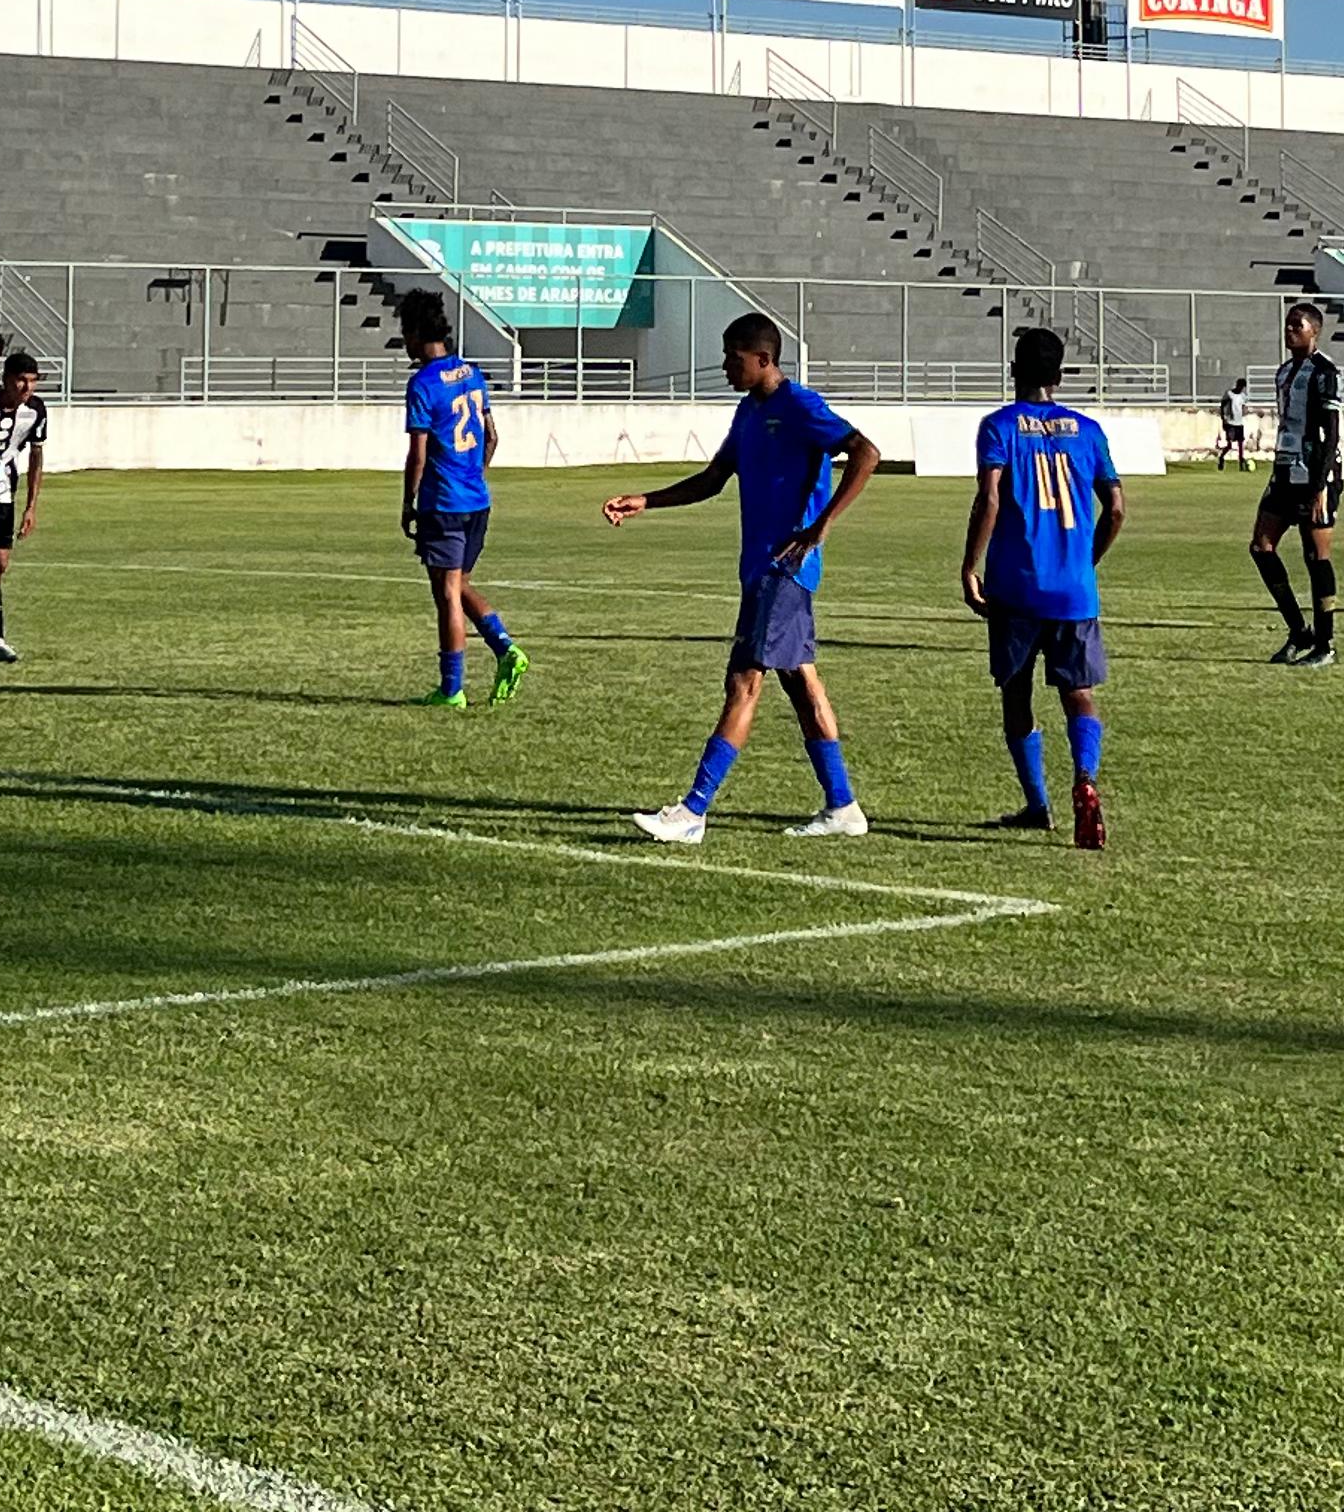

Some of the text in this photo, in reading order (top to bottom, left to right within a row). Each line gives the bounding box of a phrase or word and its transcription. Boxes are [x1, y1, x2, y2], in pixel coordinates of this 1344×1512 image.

[470, 240, 624, 259] A PREFEITURA ENTRA
[470, 262, 493, 278] EM
[495, 263, 549, 279] CAMPO
[470, 285, 513, 301] TIMES
[517, 286, 537, 301] DE
